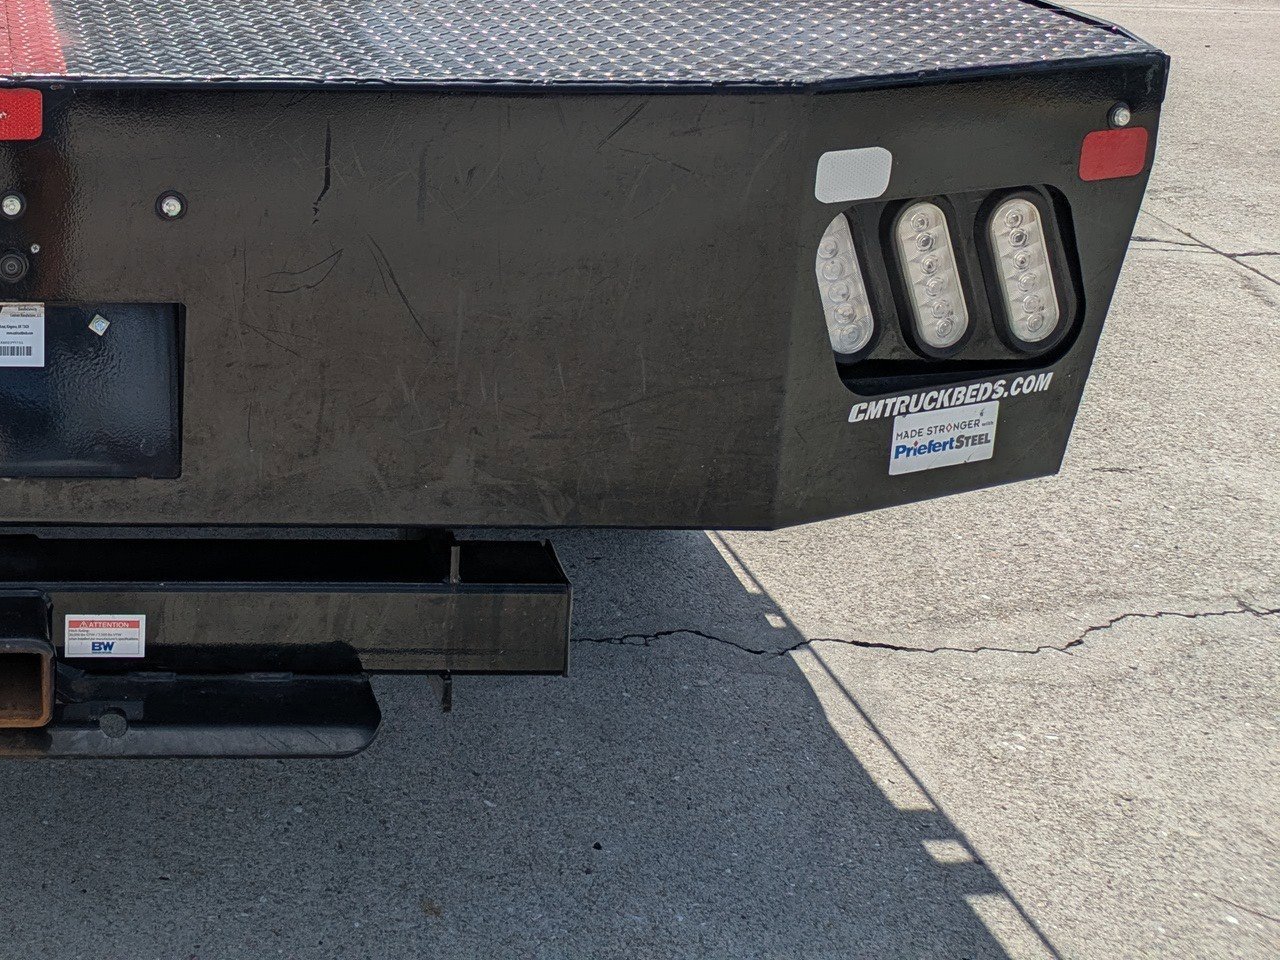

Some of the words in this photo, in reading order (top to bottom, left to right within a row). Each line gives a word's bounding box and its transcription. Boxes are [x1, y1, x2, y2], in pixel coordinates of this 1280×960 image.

[848, 372, 1054, 423] CMTRUCKBEDS.COM
[896, 428, 924, 440] MADE
[926, 419, 981, 436] STRONGER
